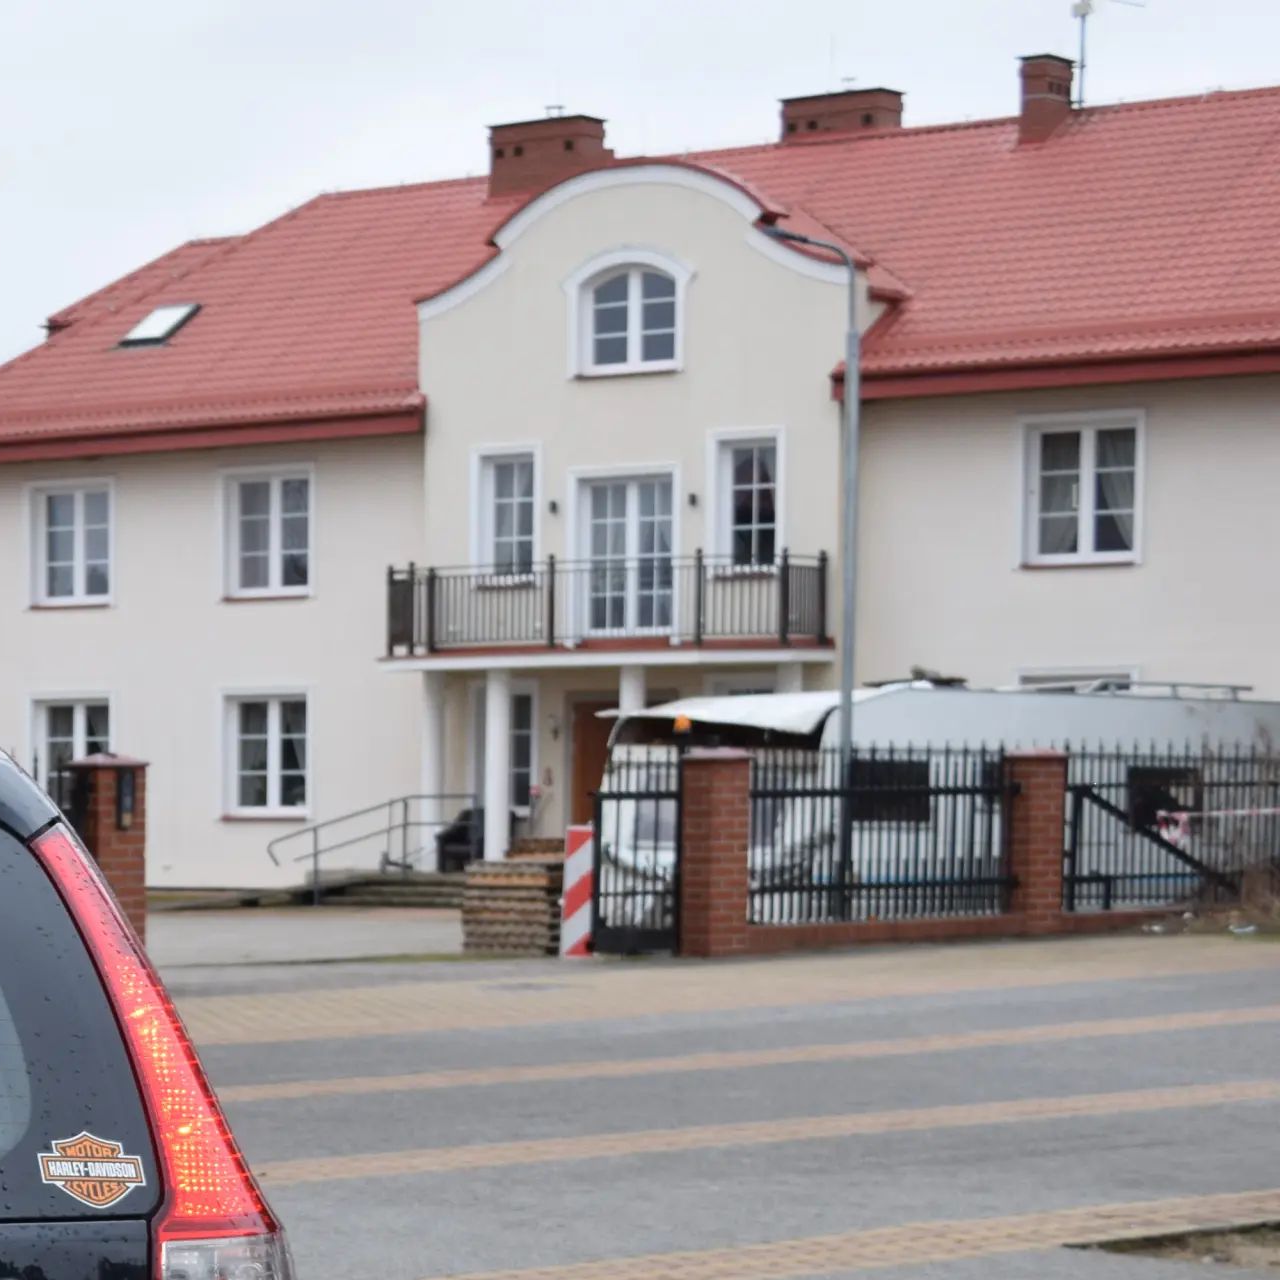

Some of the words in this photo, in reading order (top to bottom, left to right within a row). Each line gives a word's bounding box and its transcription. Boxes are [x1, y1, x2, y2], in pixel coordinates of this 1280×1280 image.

[64, 1142, 113, 1158] MOTOR
[47, 1160, 138, 1178] HARLEY-DAVIDSON
[72, 1181, 118, 1200] CYCLES
